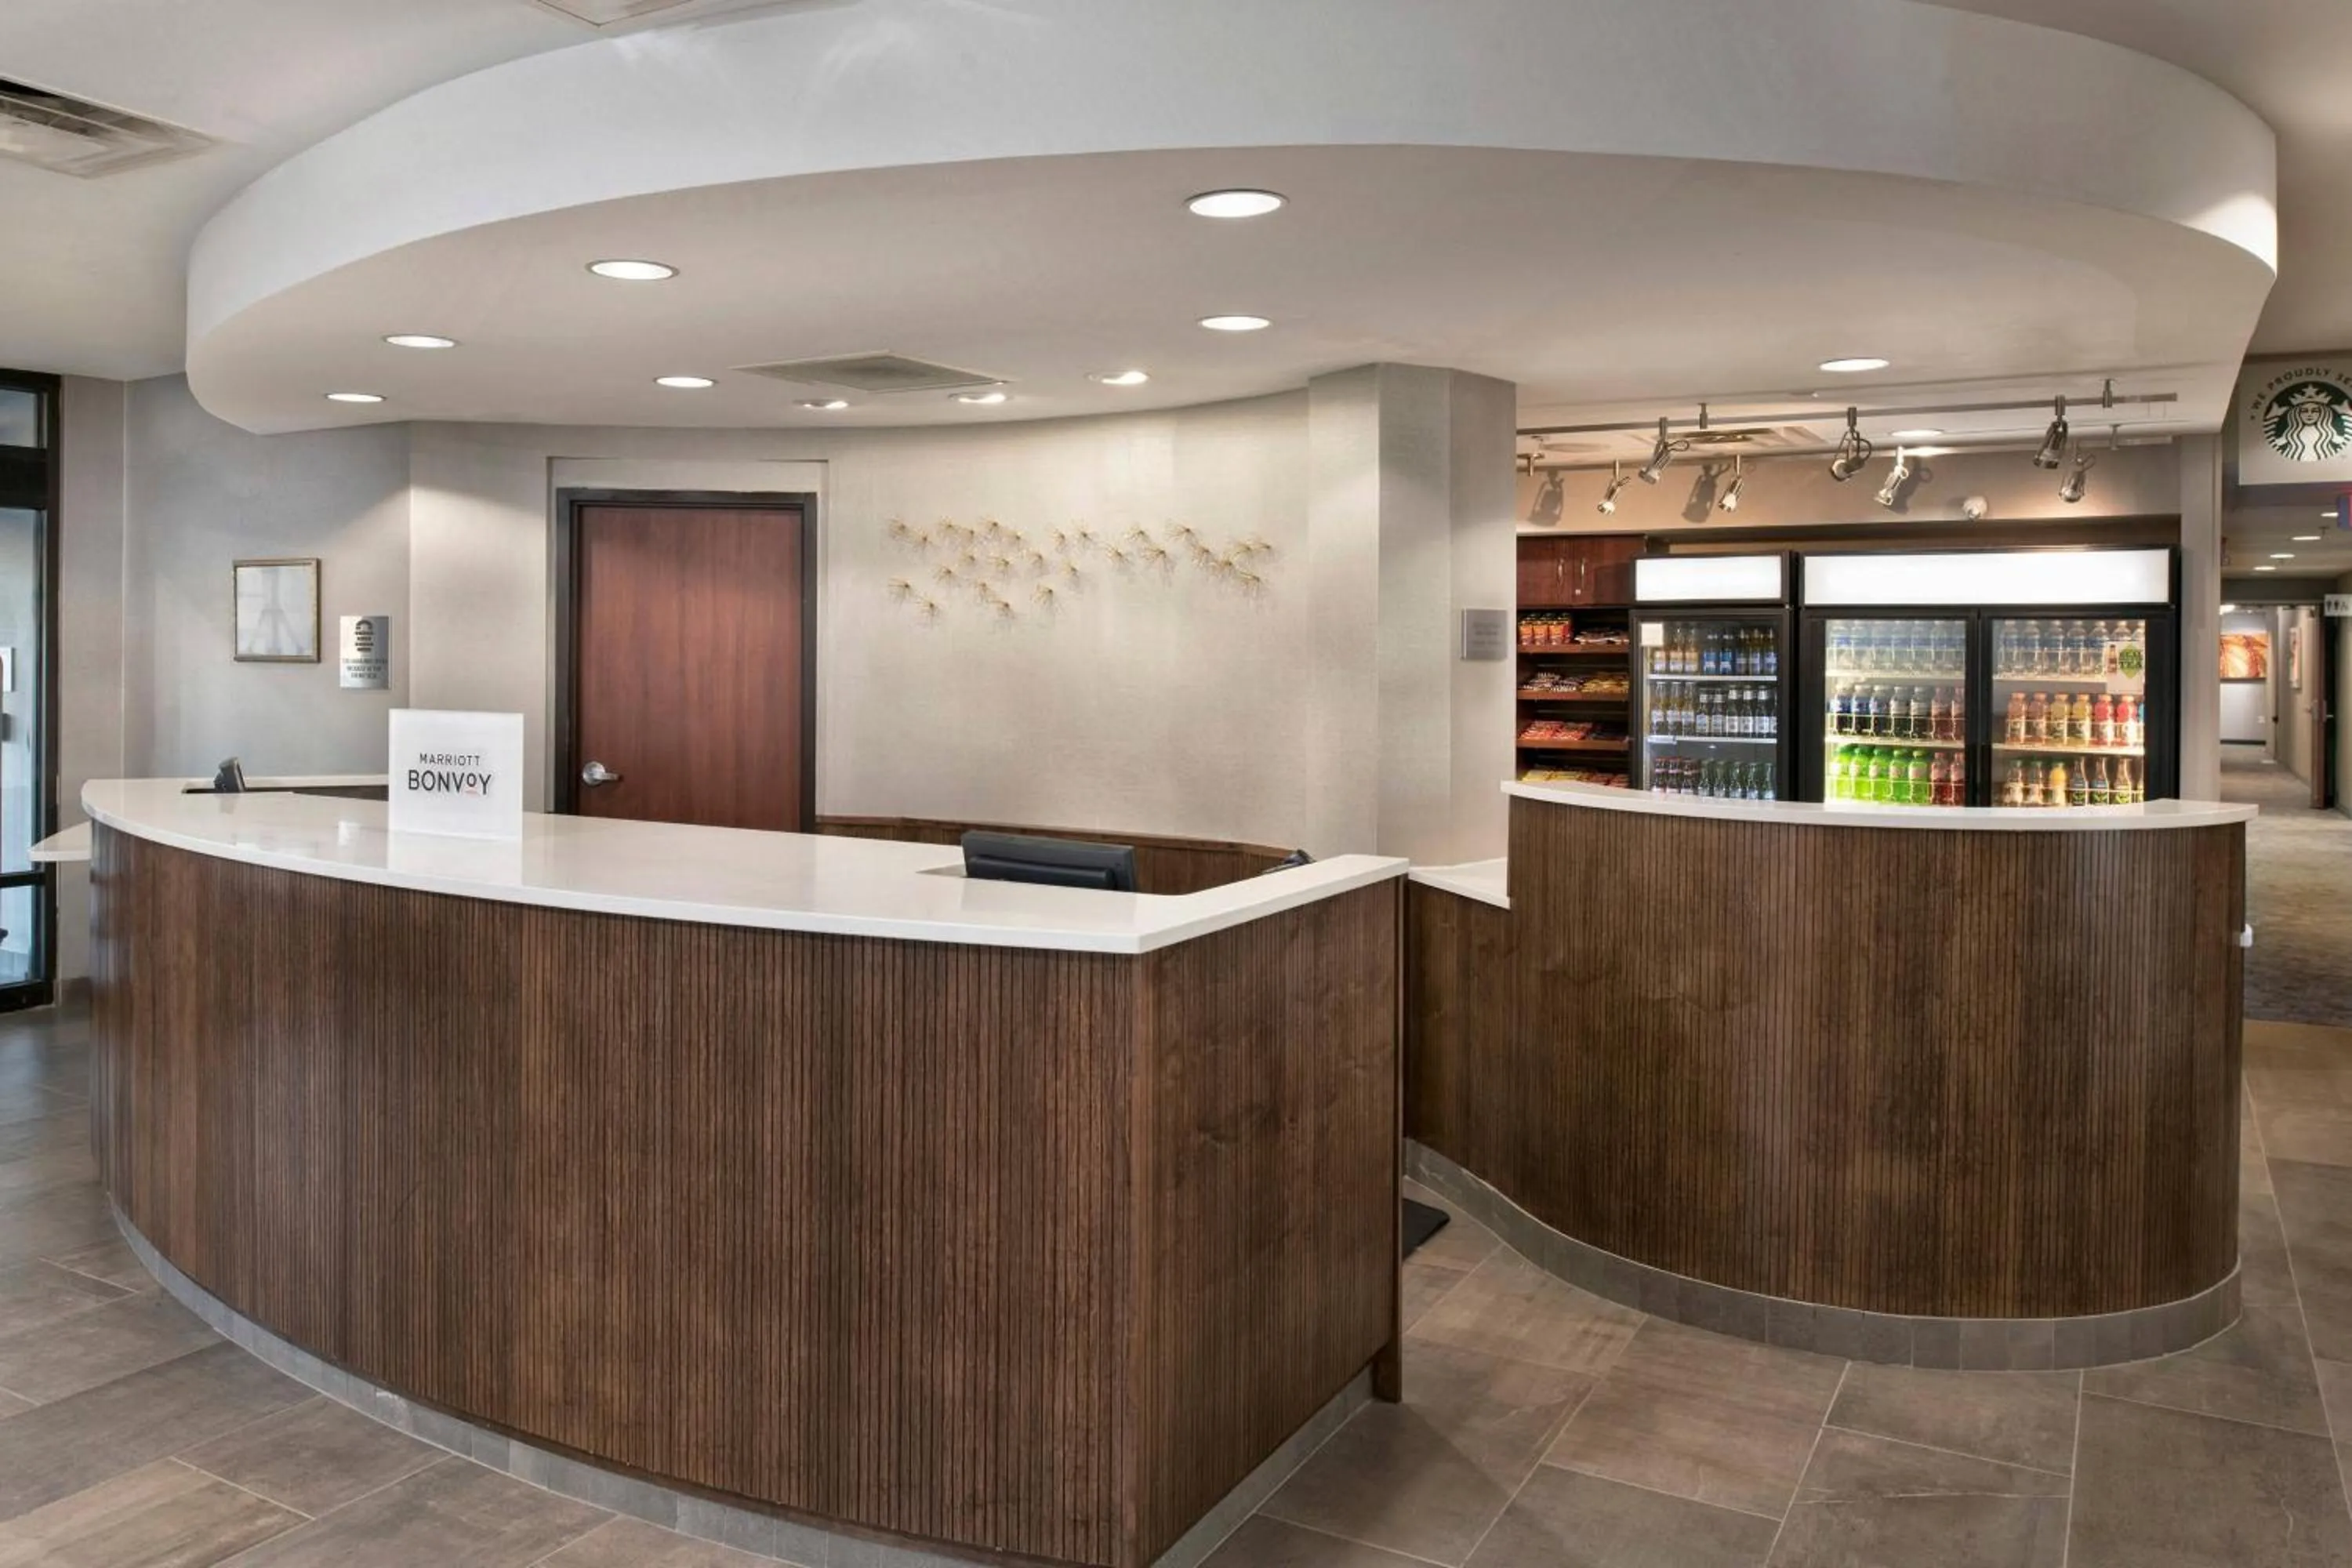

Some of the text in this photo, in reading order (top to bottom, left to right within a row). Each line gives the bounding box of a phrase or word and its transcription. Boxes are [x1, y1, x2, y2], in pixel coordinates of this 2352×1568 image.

[2252, 368, 2352, 409] WE PROUDLY SE
[419, 753, 481, 766] MARRIOTT
[408, 769, 492, 795] BONVOY
